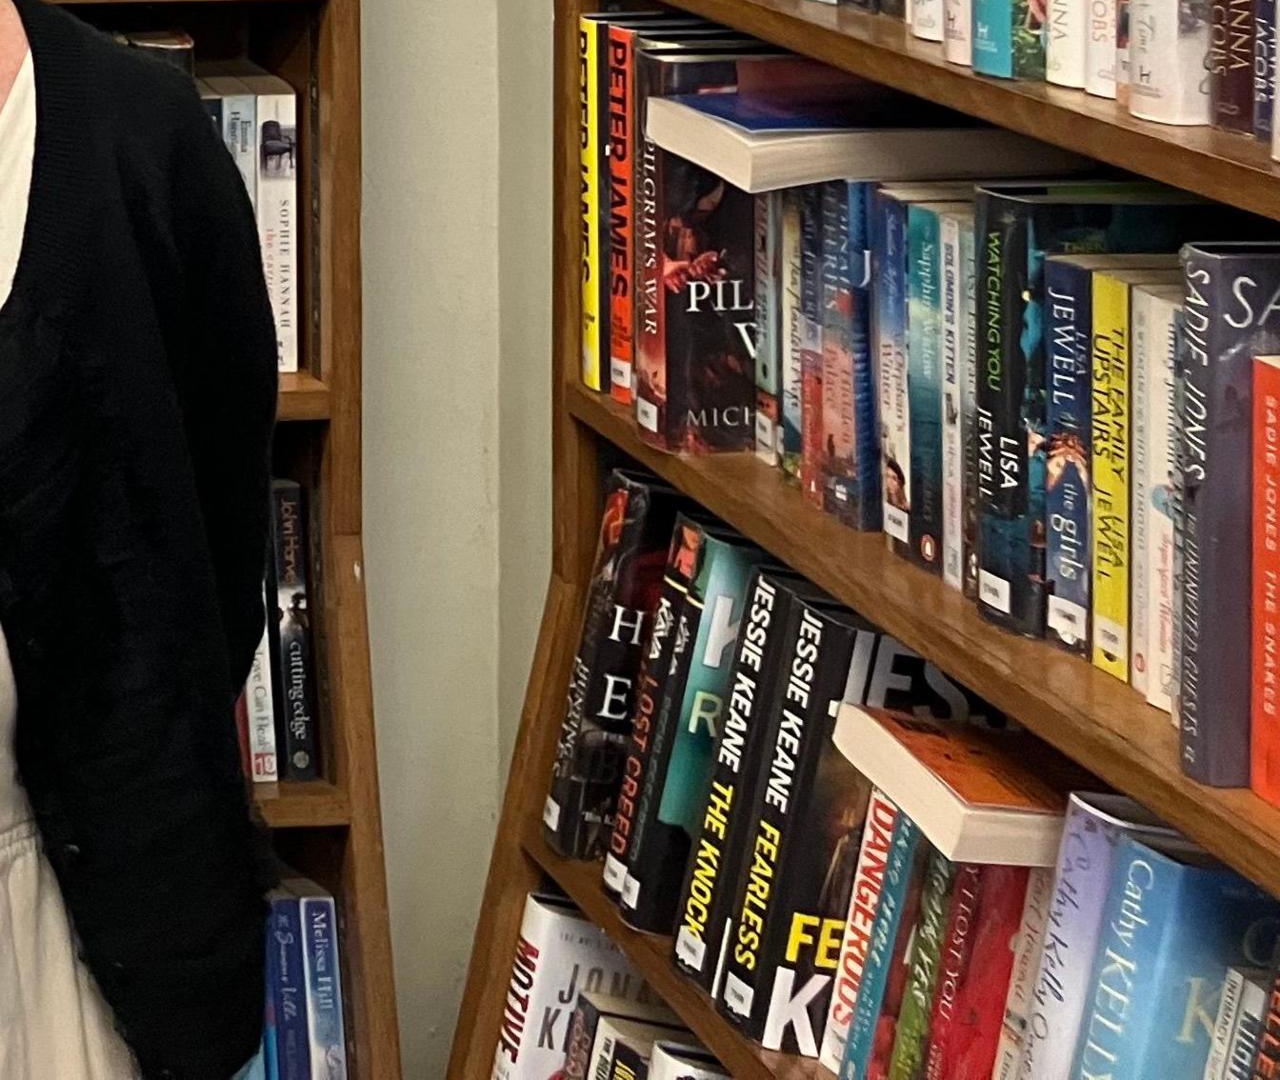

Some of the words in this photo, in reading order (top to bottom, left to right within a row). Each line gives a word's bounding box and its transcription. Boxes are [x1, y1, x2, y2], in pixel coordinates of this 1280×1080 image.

[609, 39, 627, 158] PETER
[279, 199, 289, 255] SOPHIE
[610, 169, 629, 300] JAMES
[280, 264, 290, 329] HANNAH
[988, 230, 1002, 345] WATCHING
[986, 350, 1002, 392] YOU
[1049, 287, 1075, 405] JEWELL
[1092, 333, 1113, 459] UPSTAIRS
[786, 609, 823, 708] JESSIE
[704, 783, 733, 839] THE
[766, 709, 808, 813] KEANE
[734, 819, 781, 971] FEARLESS
[831, 798, 898, 1026] DANGEROUS
[1109, 859, 1154, 949] Cathy
